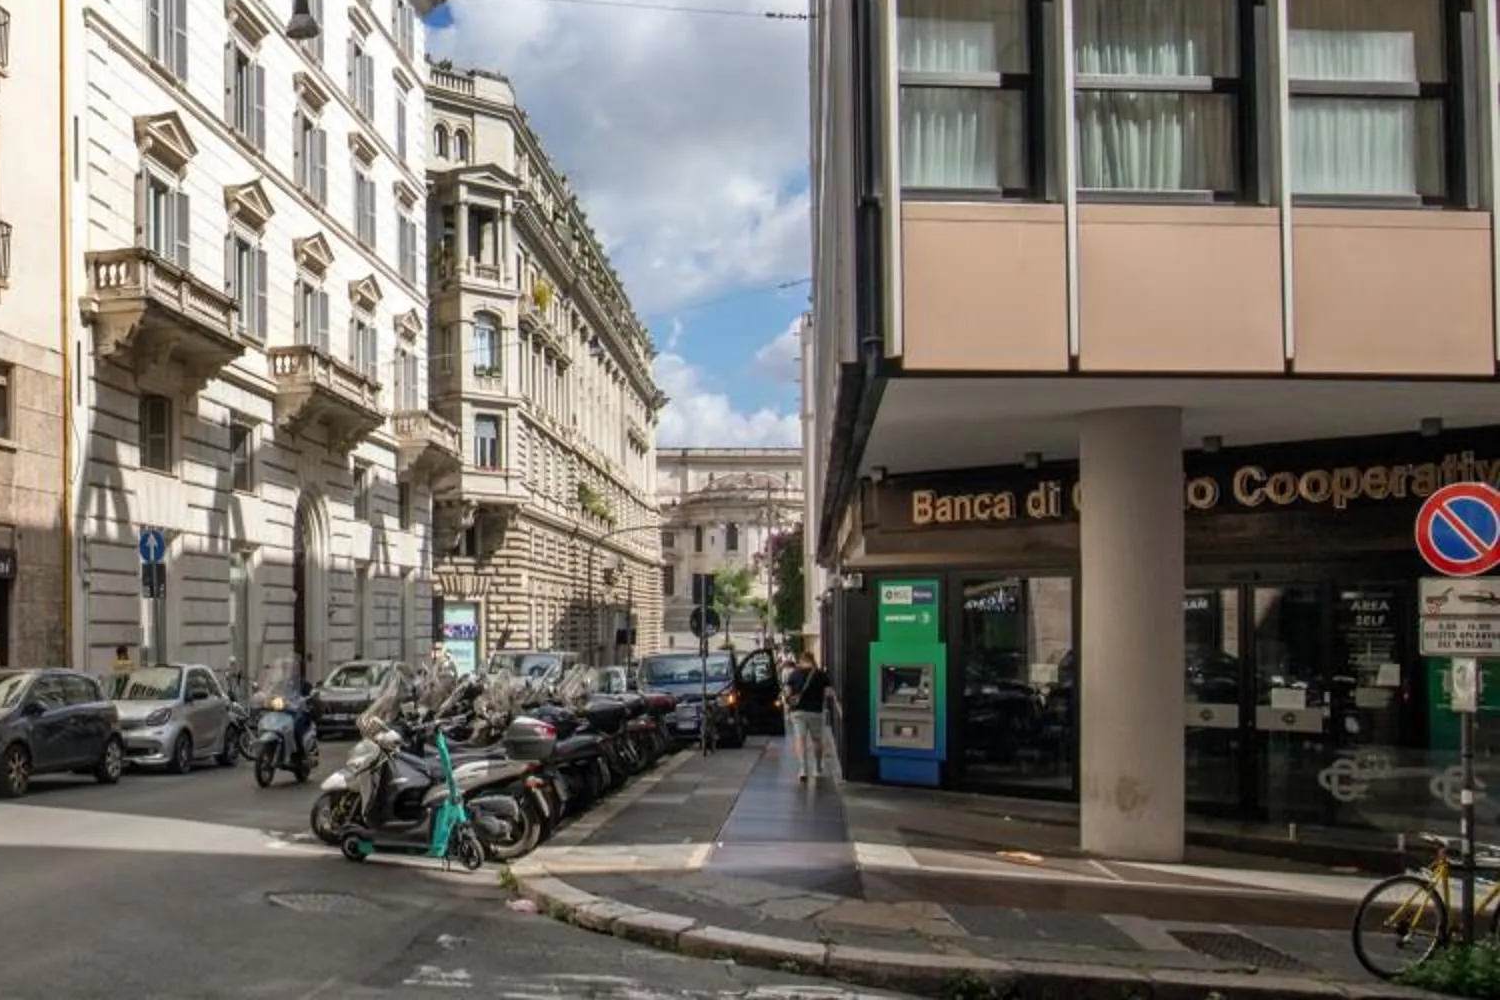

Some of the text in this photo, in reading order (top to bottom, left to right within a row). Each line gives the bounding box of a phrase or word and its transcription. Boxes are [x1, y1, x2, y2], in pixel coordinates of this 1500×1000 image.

[911, 489, 1016, 525] Banca
[1026, 480, 1061, 518] di
[1349, 600, 1391, 611] AREA
[1355, 614, 1386, 627] SELF
